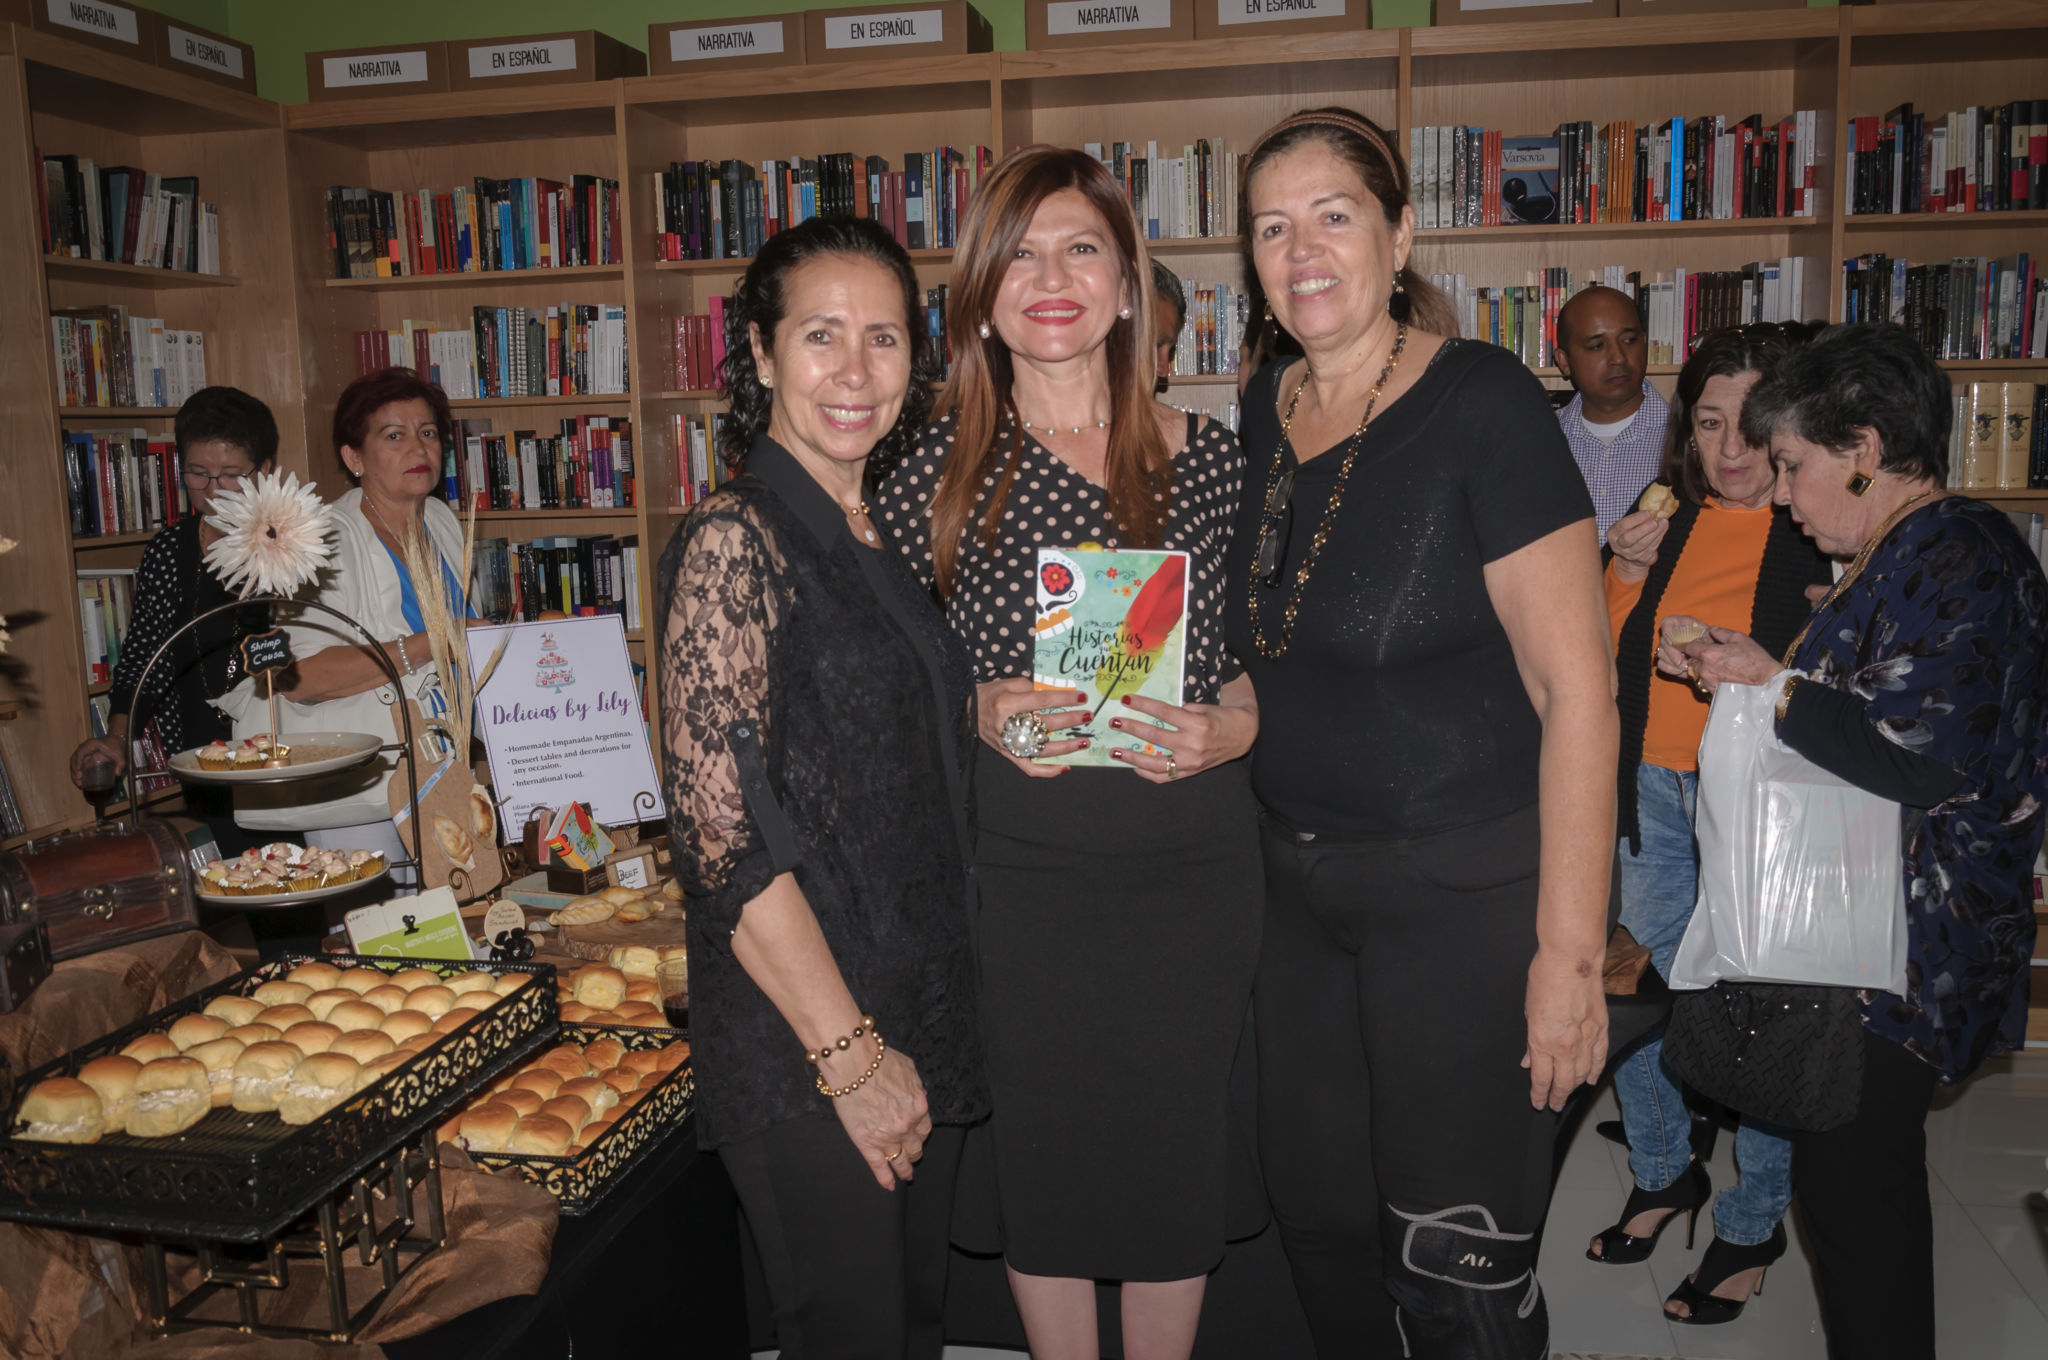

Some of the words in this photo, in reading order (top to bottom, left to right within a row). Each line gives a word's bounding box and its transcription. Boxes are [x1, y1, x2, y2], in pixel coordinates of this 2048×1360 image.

[70, 2, 117, 32] NARRATIVA
[1077, 5, 1140, 26] NARRATIVA
[1246, 0, 1261, 14] EN
[851, 23, 865, 40] EN
[869, 18, 916, 38] ESPAÑOL
[698, 31, 755, 52] NARRATIVA
[185, 38, 196, 57] EN
[197, 43, 228, 68] ESPAÑOL
[492, 52, 505, 69] EN
[509, 47, 552, 67] ESPAÑOL
[349, 60, 402, 79] NARRATIVA
[1502, 151, 1545, 163] Varsovia
[250, 639, 281, 653] Shrimp
[1068, 625, 1144, 650] Historias
[252, 650, 285, 665] Causa
[1059, 647, 1153, 675] Cuentan
[492, 702, 559, 725] Delicias
[565, 698, 591, 721] by
[597, 690, 632, 716] Lily
[508, 741, 551, 753] Homemade
[552, 736, 593, 747] Empanadas
[594, 730, 633, 742] Argentinas.
[511, 755, 539, 766] Dessert
[540, 752, 563, 762] tables
[564, 751, 578, 759] and
[579, 744, 620, 756] decorations
[621, 743, 632, 751] for
[513, 767, 526, 775] any
[528, 763, 562, 773] occasion.
[516, 774, 564, 787] International
[564, 770, 585, 780] Food.
[618, 868, 639, 882] BEEF
